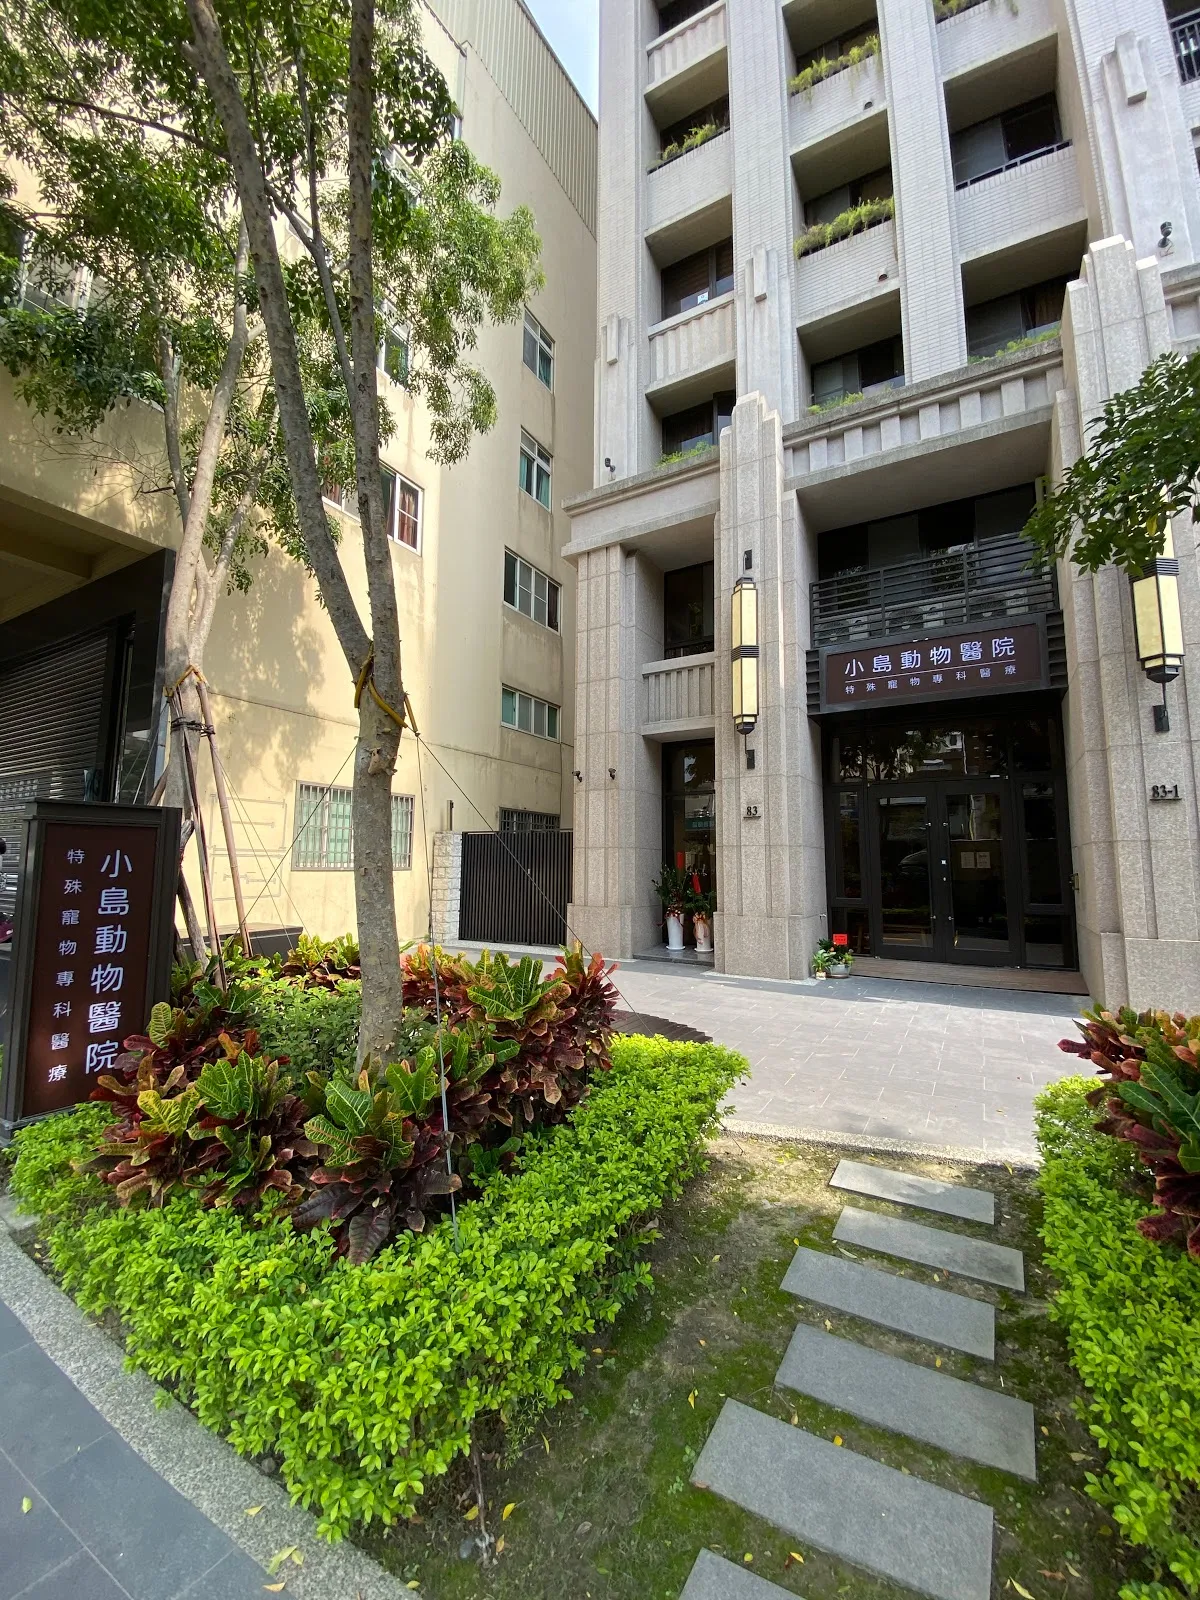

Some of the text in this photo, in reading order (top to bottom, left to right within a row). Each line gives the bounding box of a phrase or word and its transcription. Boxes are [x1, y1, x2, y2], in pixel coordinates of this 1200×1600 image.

[844, 637, 1016, 677] 小島動物醫院
[746, 805, 758, 816] 83
[1152, 784, 1180, 798] 83-1
[48, 848, 86, 1083] 特殊寵物專科醫療
[85, 849, 133, 1075] 小島動物醫院
